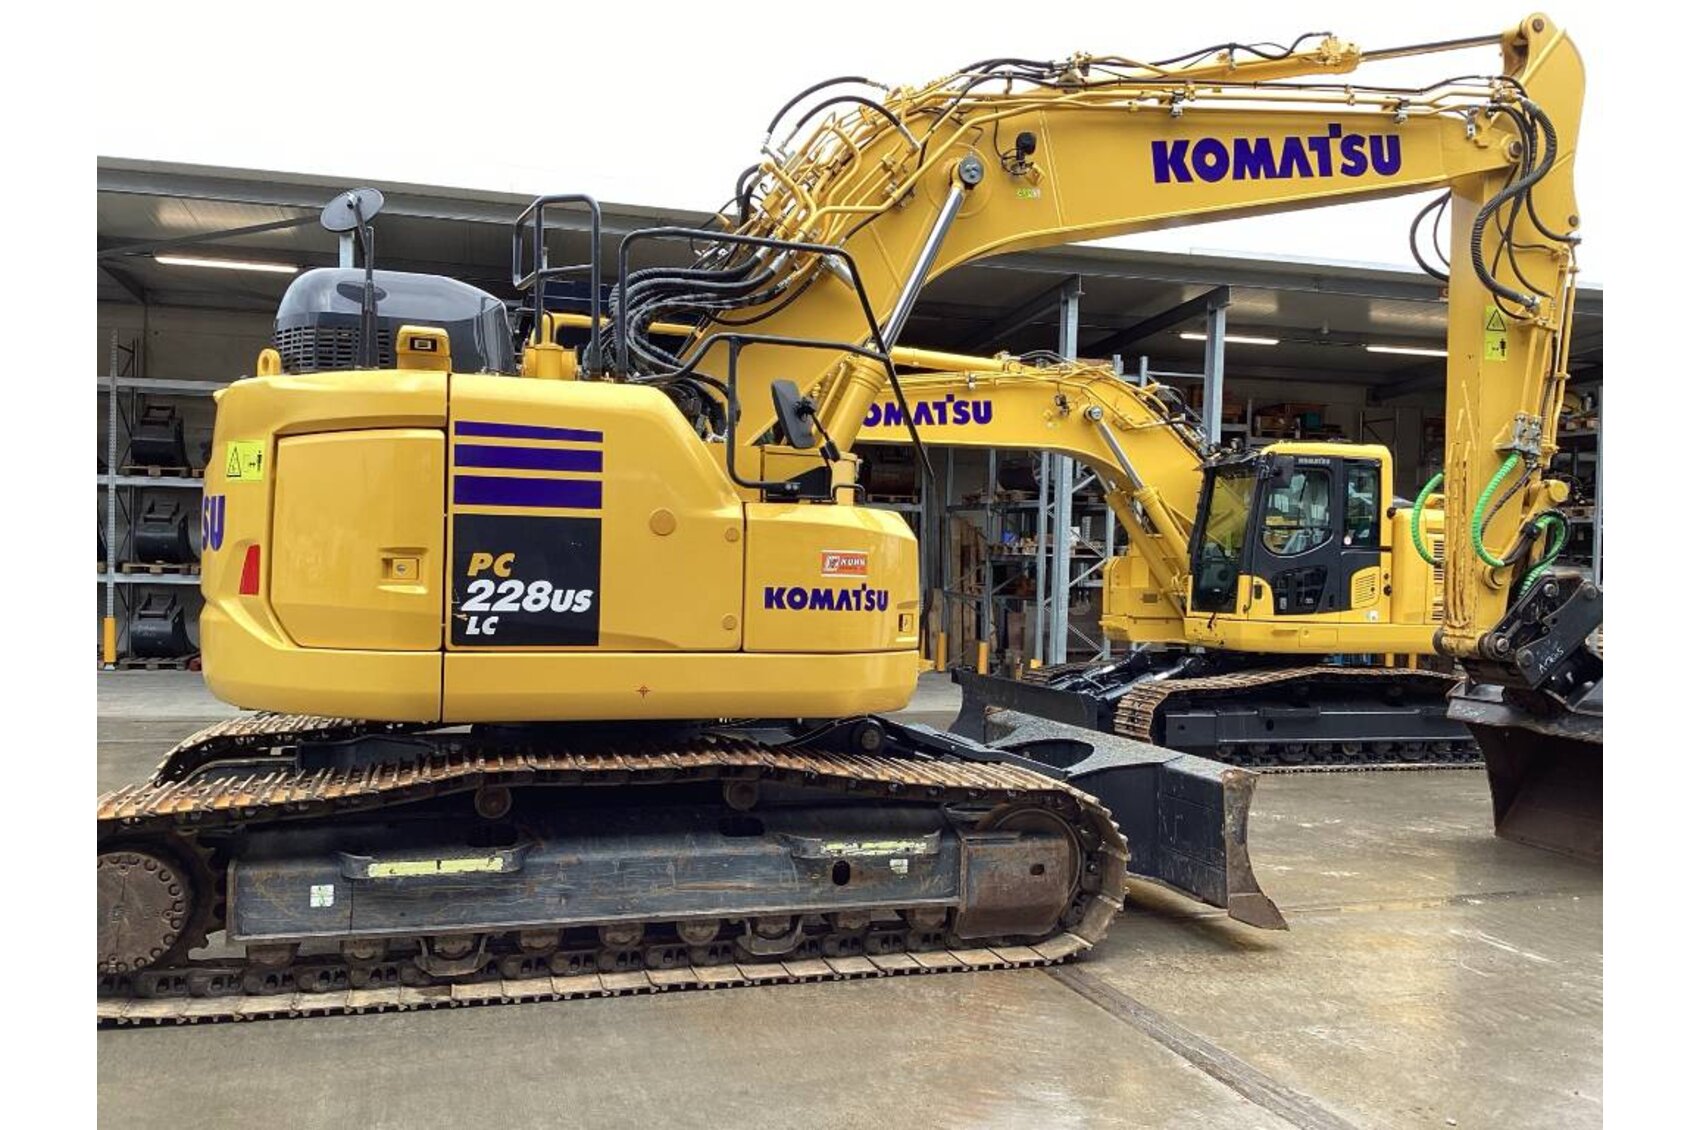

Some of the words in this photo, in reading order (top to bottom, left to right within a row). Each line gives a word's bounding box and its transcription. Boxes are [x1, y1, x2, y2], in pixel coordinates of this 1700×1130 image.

[1151, 123, 1402, 183] KOMATSU
[467, 552, 516, 578] PC
[764, 583, 889, 612] KOMATSU
[465, 616, 499, 635] LC
